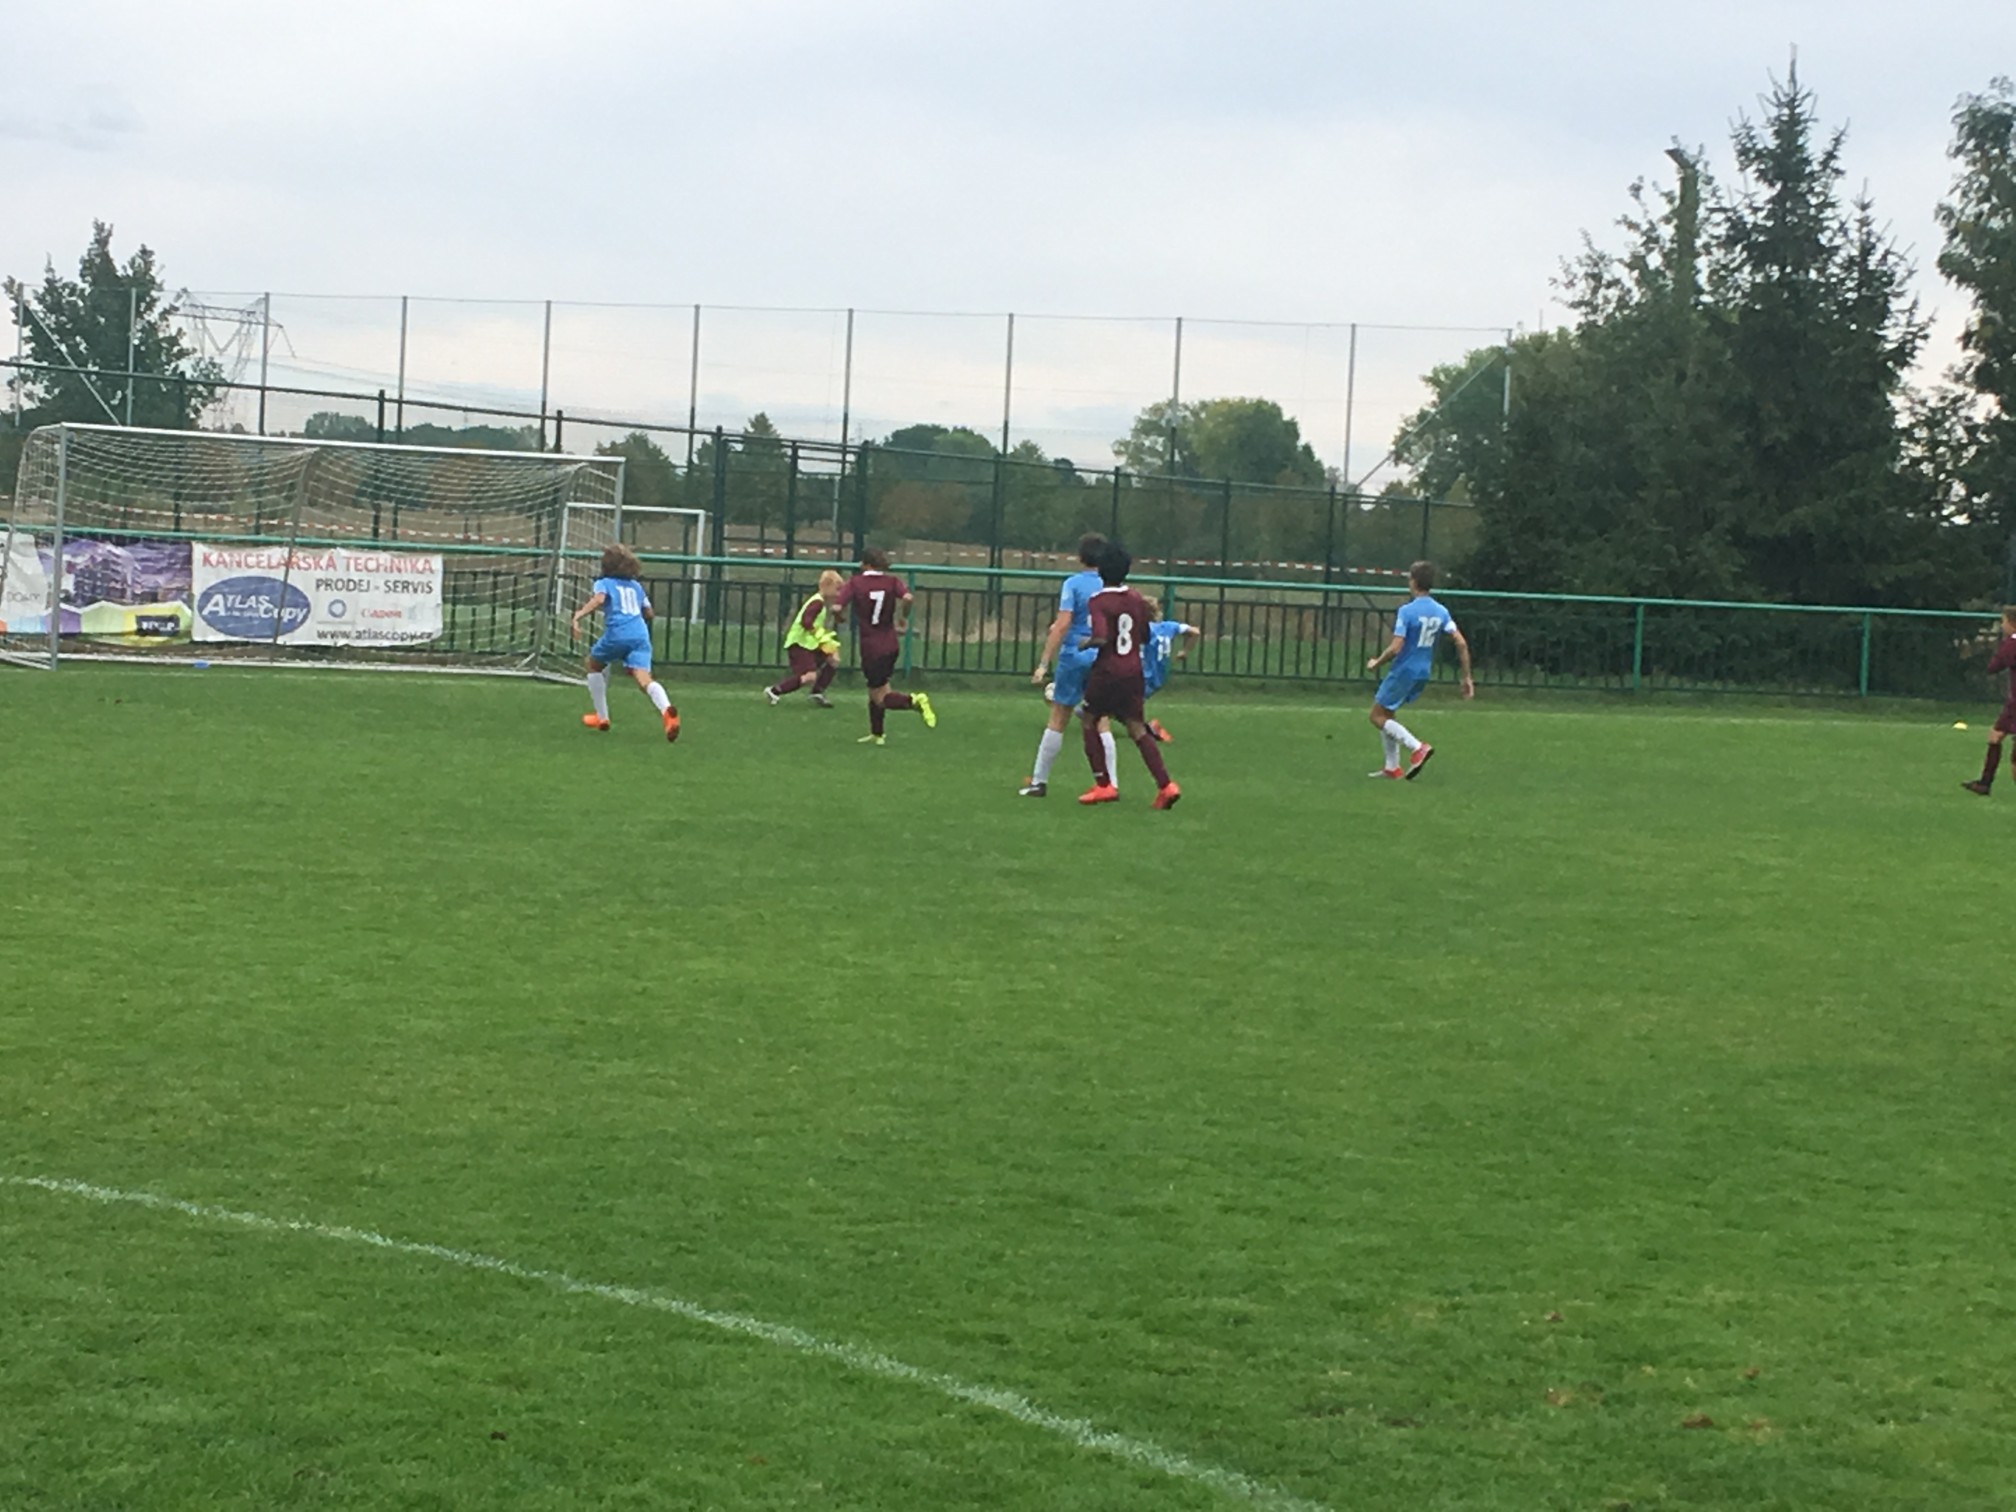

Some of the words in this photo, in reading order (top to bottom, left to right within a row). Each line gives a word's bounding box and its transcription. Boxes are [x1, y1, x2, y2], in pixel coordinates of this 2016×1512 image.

[342, 556, 435, 575] TECHNIKA
[315, 578, 371, 592] PRODEJ
[383, 580, 434, 595] SERVIS
[615, 585, 641, 617] 10
[869, 590, 886, 625] 7
[316, 627, 434, 642] www.atlascopy.cz
[1116, 613, 1133, 656] 8
[1416, 616, 1443, 648] 12
